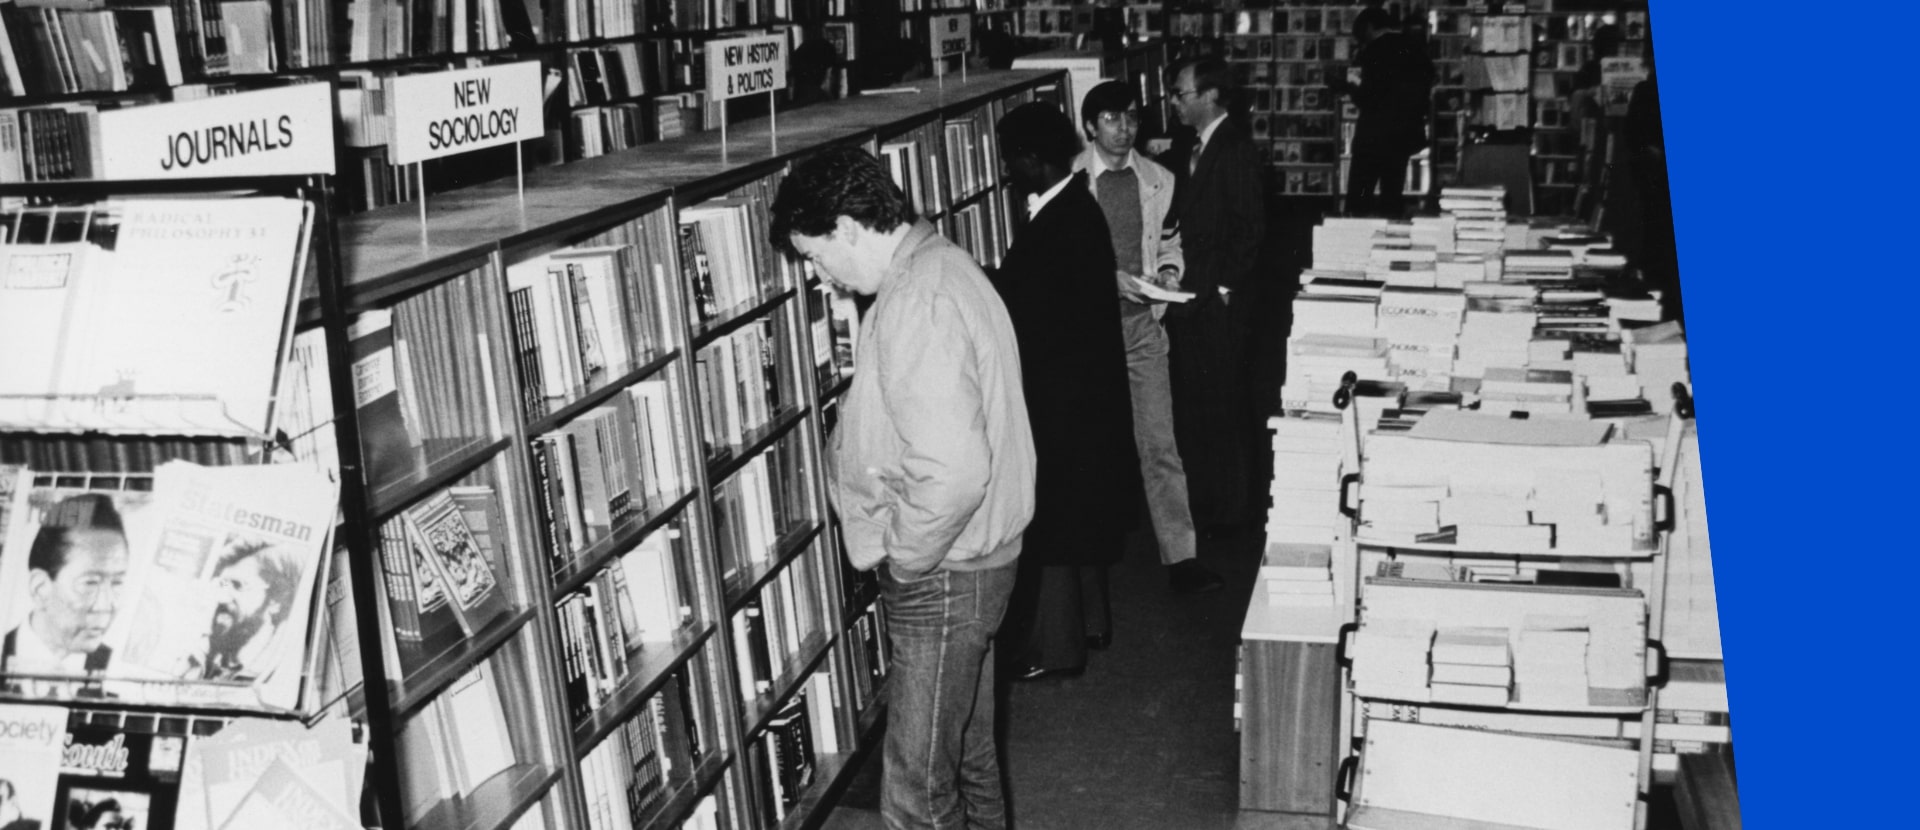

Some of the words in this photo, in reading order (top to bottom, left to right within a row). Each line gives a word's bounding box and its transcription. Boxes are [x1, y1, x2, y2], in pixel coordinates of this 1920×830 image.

[724, 45, 744, 67] NEW
[747, 42, 779, 65] HISTORY
[453, 77, 491, 109] NEW
[727, 74, 734, 95] &
[737, 67, 774, 93] POLITICS
[429, 106, 519, 150] SOCIOLOGY
[161, 114, 293, 171] JOURNALS
[133, 211, 212, 225] RADICAL
[129, 226, 242, 239] PHILOSOPHY
[1381, 306, 1438, 317] ECONOMICS
[180, 487, 312, 542] Statesman
